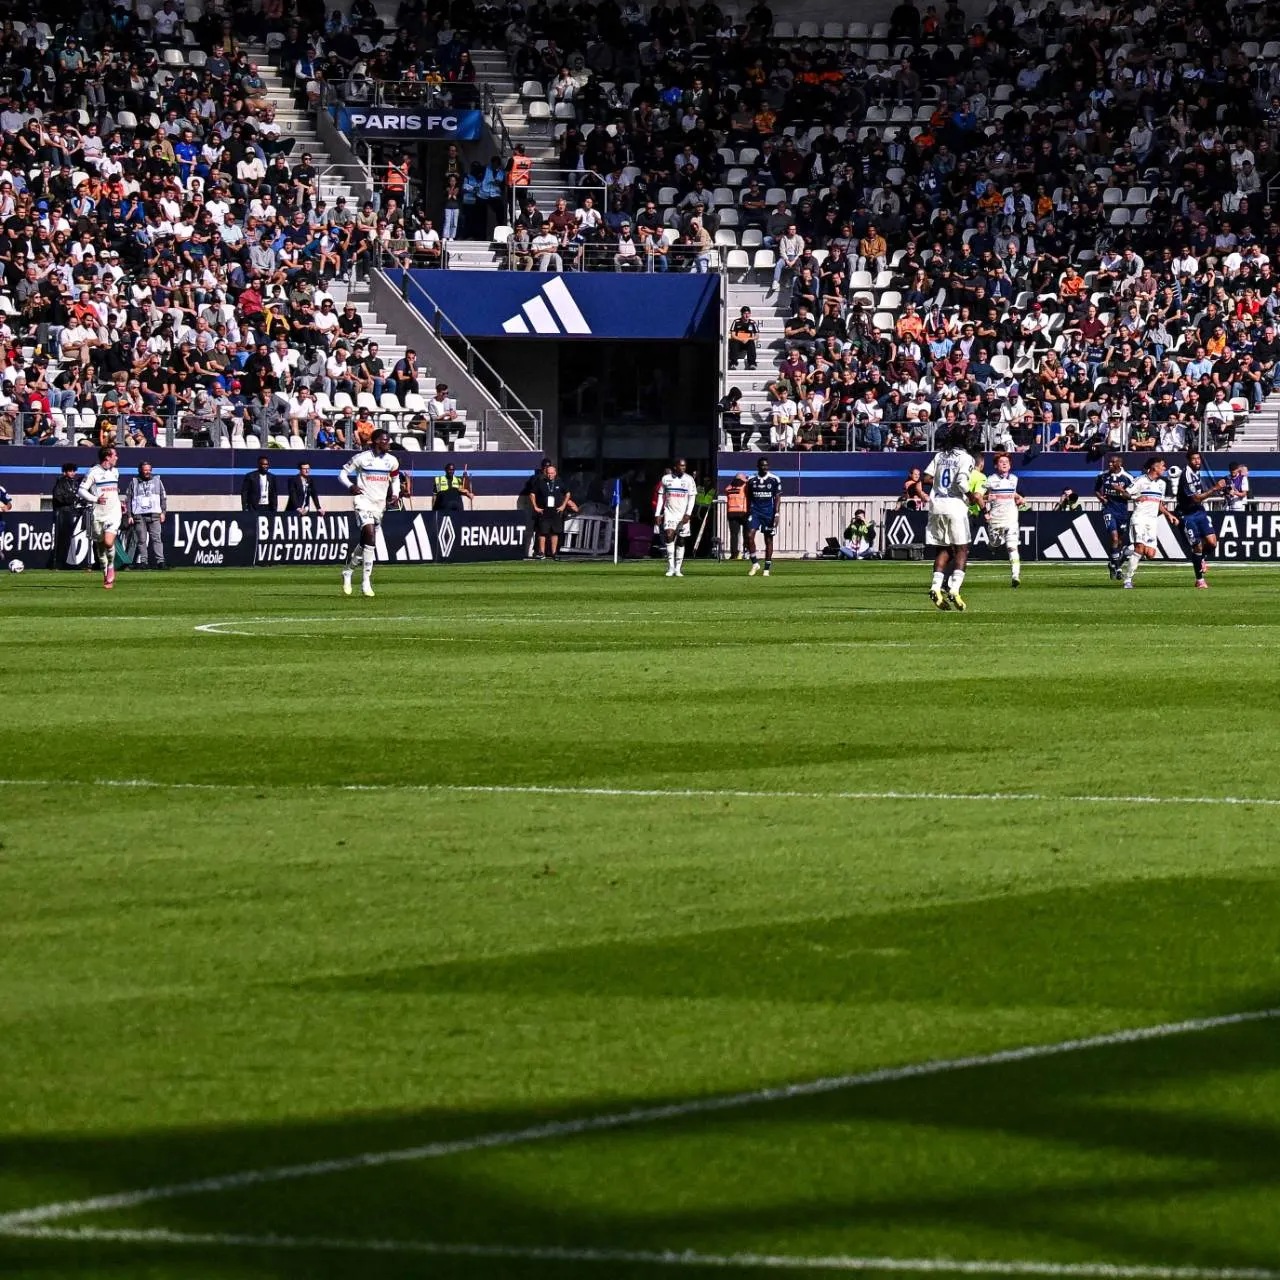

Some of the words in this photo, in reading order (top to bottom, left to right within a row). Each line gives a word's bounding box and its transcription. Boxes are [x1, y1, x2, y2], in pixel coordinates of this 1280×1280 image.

[351, 114, 422, 130] PARIS
[427, 116, 458, 131] FC
[941, 468, 951, 488] 6
[18, 523, 55, 551] Pixel
[174, 514, 226, 554] Lyca
[258, 516, 350, 540] BAHRAIN
[460, 526, 526, 546] RENAULT
[194, 550, 224, 564] Mobile
[258, 543, 349, 561] VICTORIOUS
